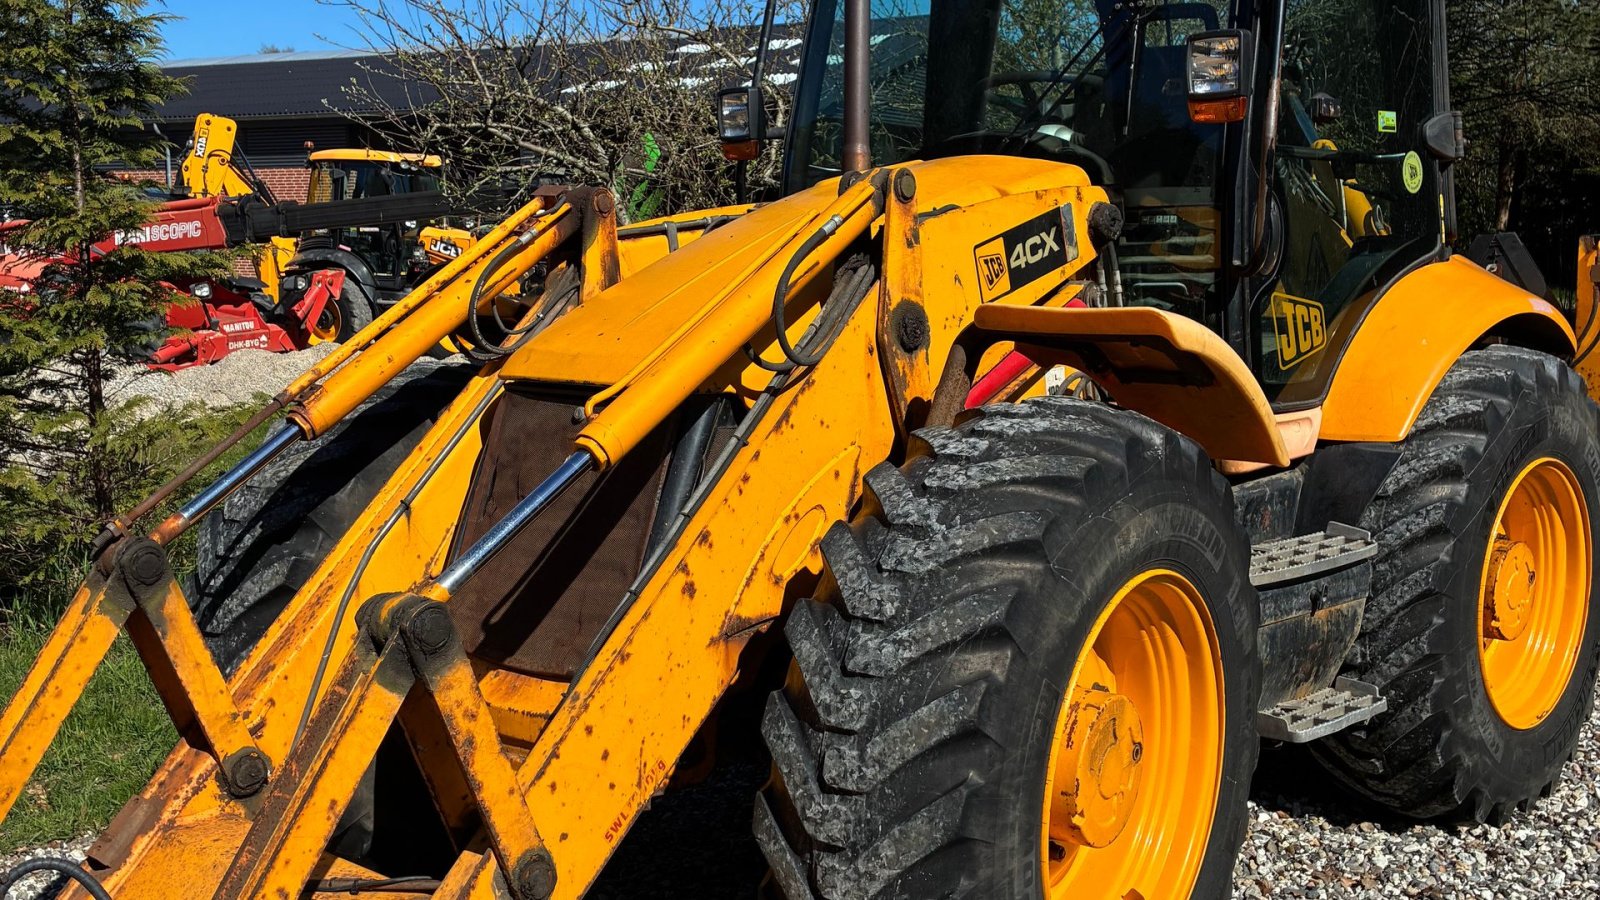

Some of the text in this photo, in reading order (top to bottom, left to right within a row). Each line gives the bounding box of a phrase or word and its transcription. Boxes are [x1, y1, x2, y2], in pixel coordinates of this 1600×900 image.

[1010, 226, 1060, 270] 4CX
[983, 256, 1005, 286] JCB
[223, 321, 254, 333] MANITOU
[1281, 301, 1324, 361] JCB
[229, 338, 259, 350] DHK-BYG
[604, 811, 630, 843] SWL
